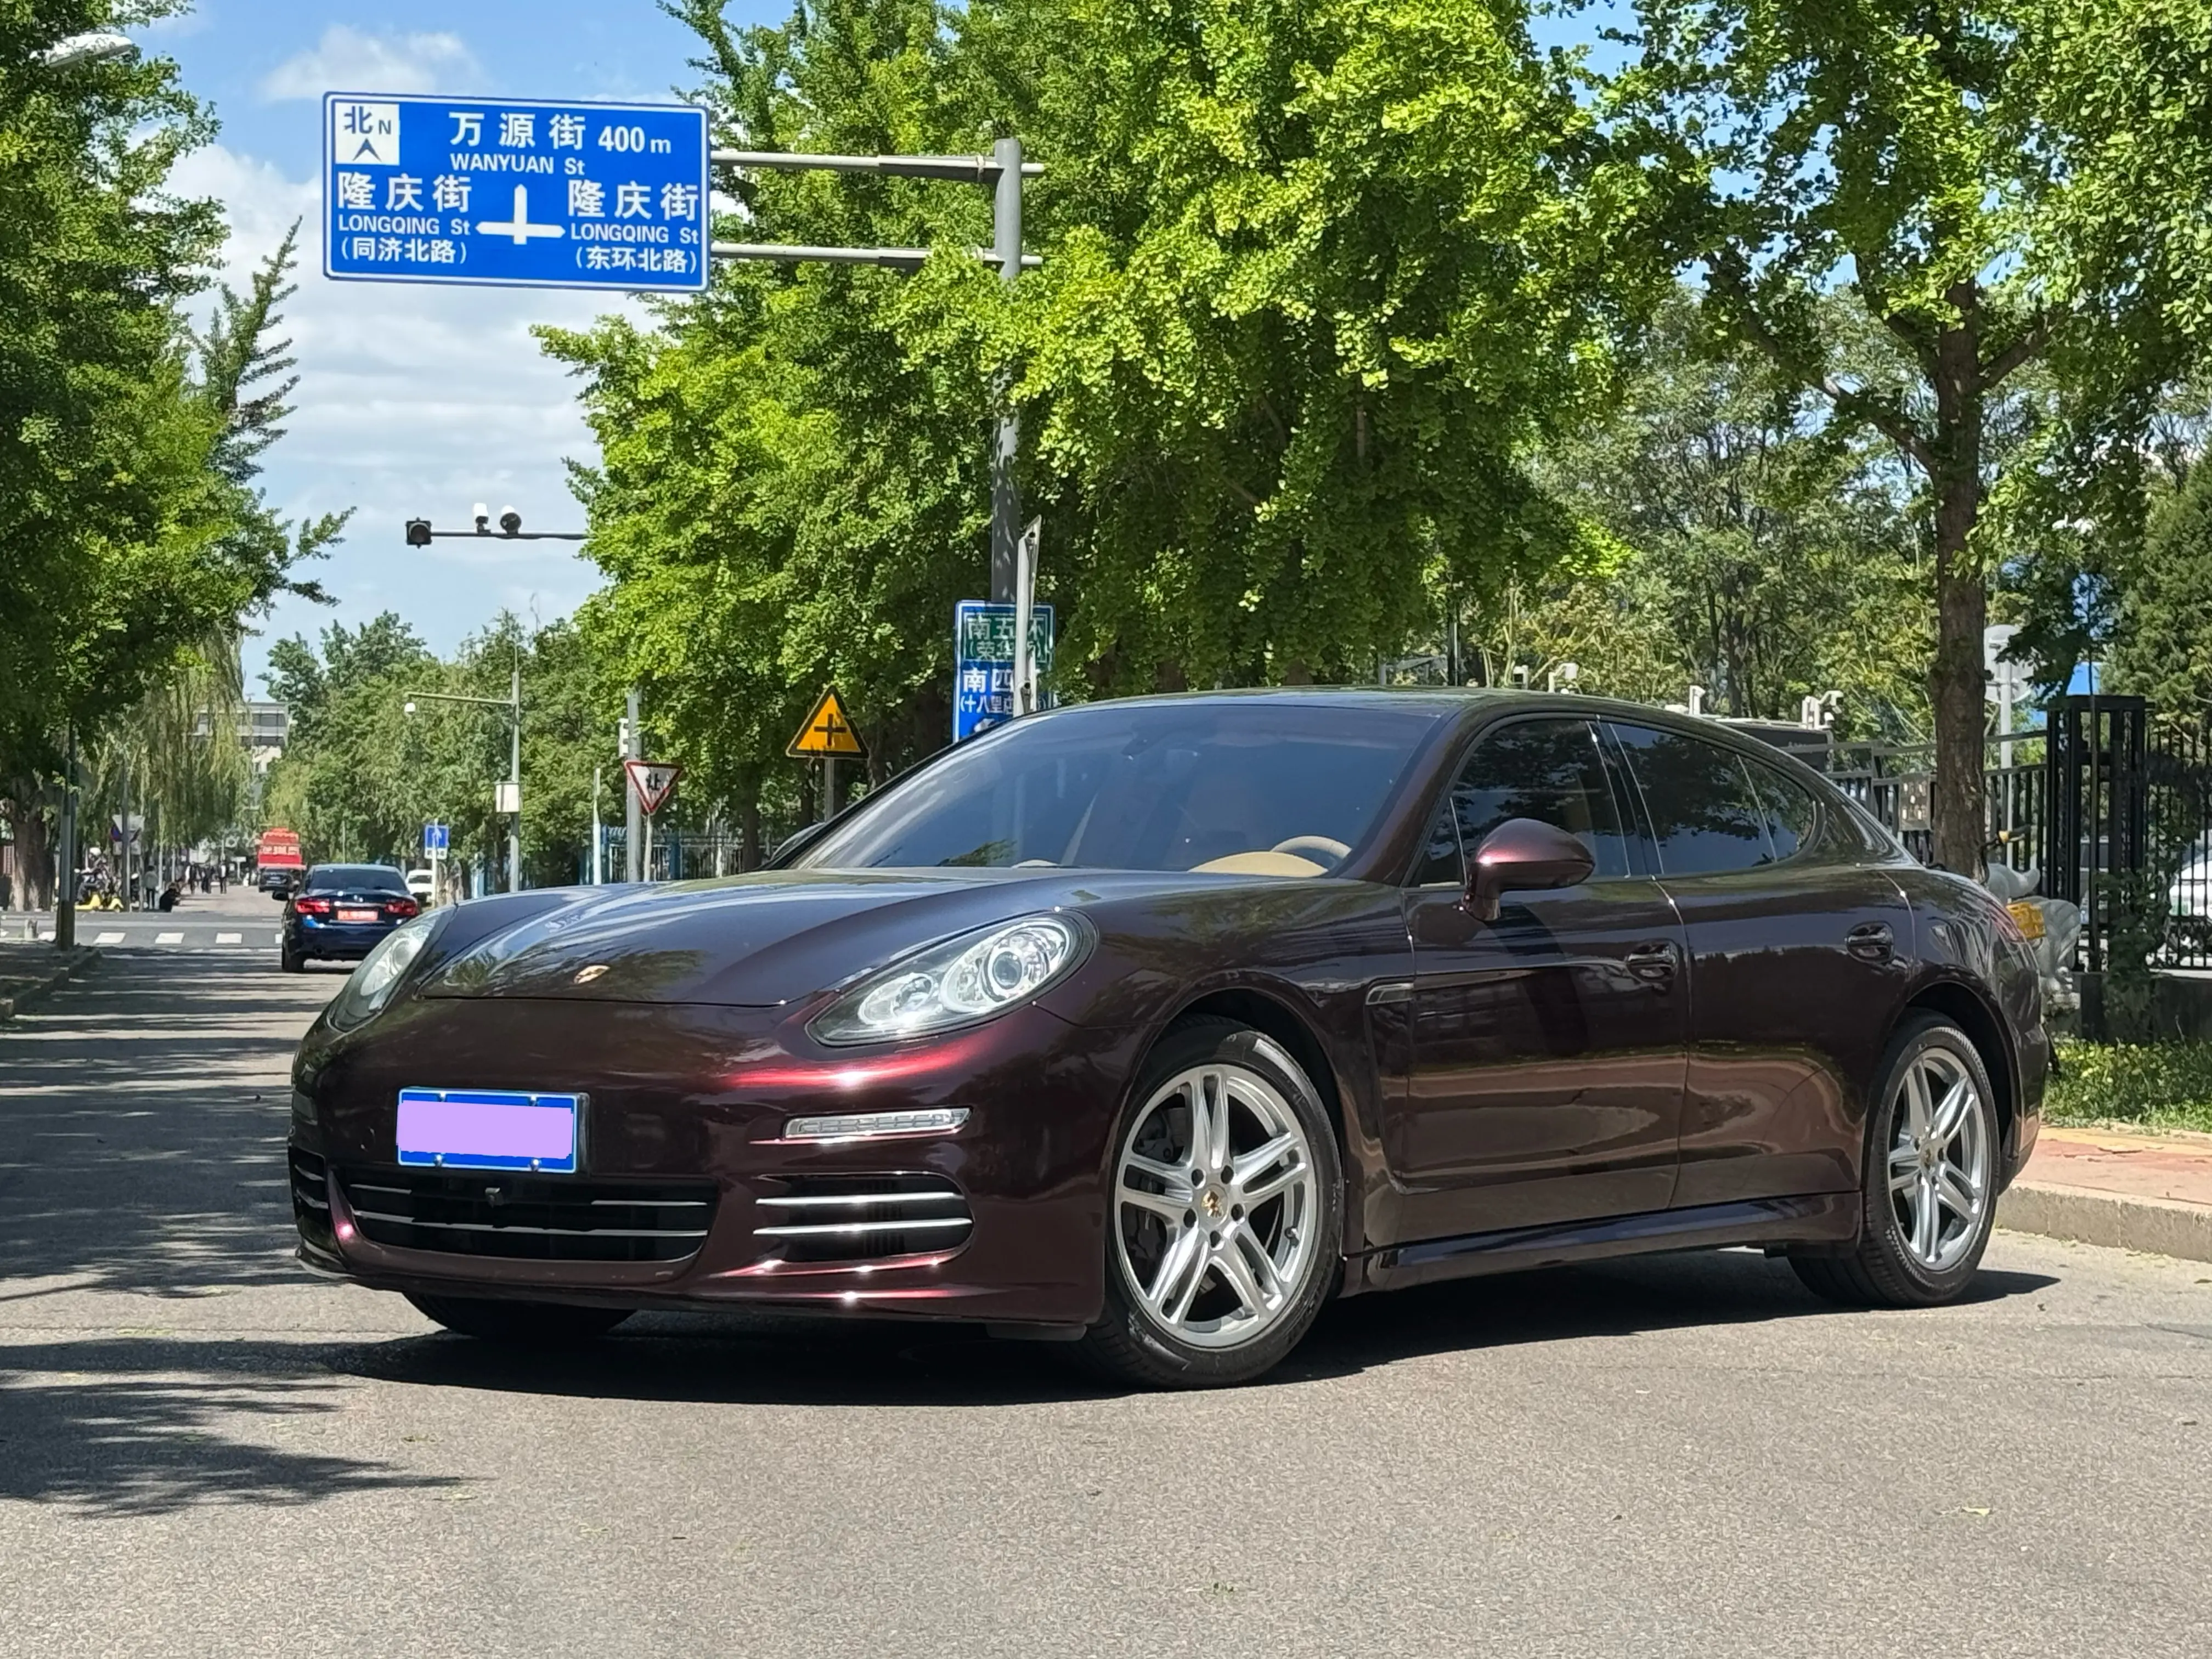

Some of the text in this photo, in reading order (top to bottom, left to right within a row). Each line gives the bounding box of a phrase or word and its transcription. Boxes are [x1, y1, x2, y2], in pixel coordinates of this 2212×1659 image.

[343, 106, 391, 134] 北 N
[449, 112, 671, 154] 万源街 400 m
[450, 153, 585, 176] WANYUAN St
[338, 172, 472, 212] 隆庆街
[568, 179, 698, 221] 隆庆街
[339, 215, 470, 235] LONGQING St
[571, 223, 699, 244] LONGQING St
[342, 236, 466, 264] (同济北路)
[576, 245, 697, 274] (东环北路)
[963, 667, 1041, 693] 南四
